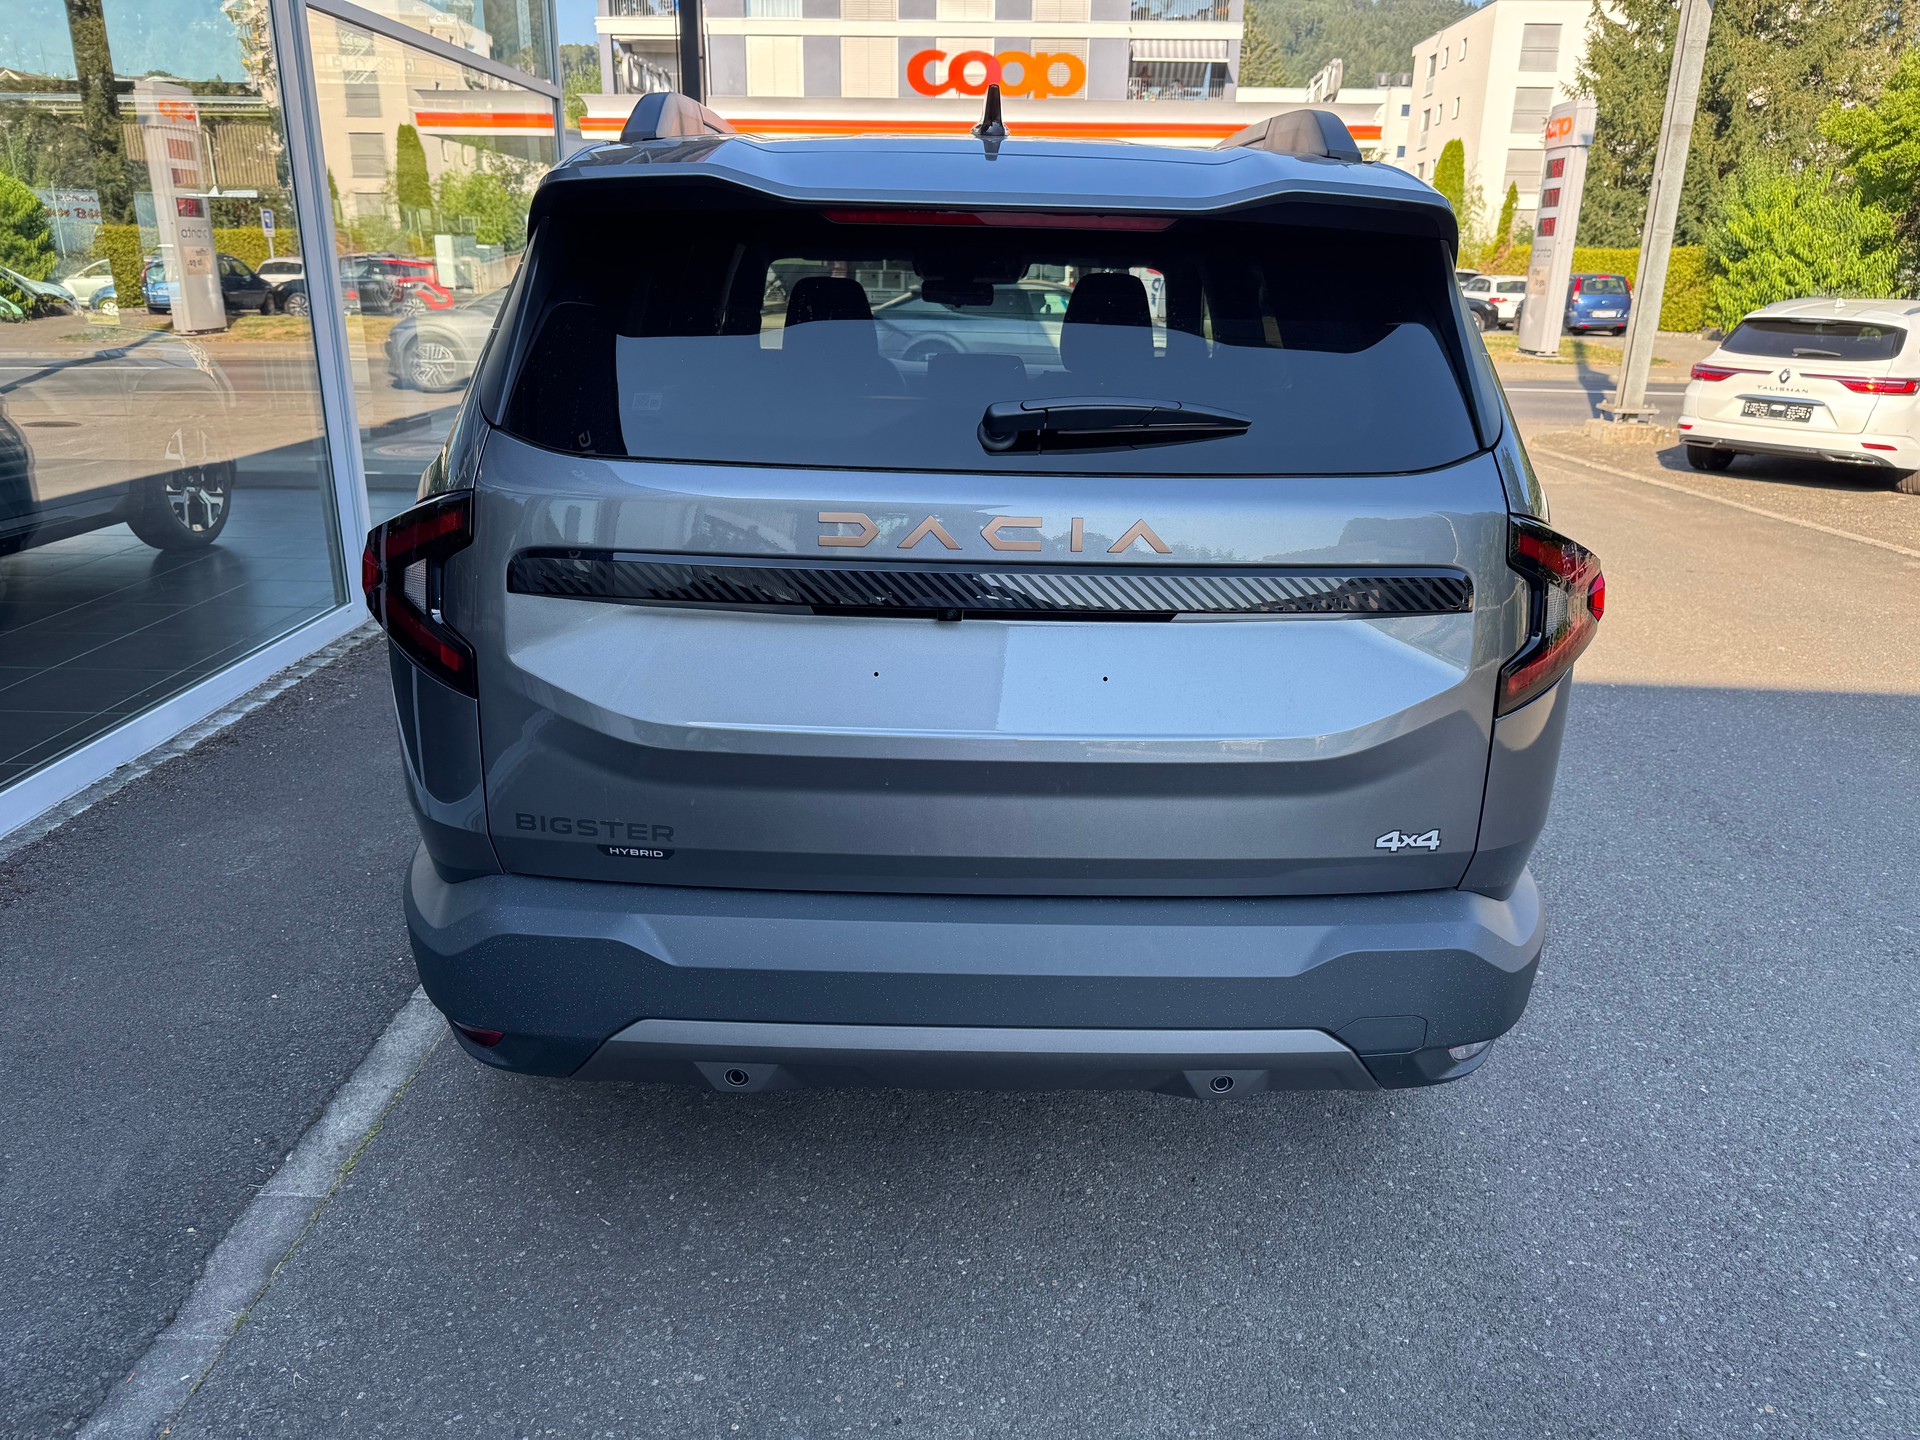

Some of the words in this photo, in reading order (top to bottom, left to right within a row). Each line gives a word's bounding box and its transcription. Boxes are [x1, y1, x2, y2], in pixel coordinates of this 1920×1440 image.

[907, 49, 1086, 99] coop
[1756, 384, 1809, 394] TALISMAN
[817, 511, 1173, 554] DACIA
[514, 812, 675, 843] BIGSTER
[1375, 829, 1441, 852] 4x4
[608, 846, 665, 859] HYBRID
